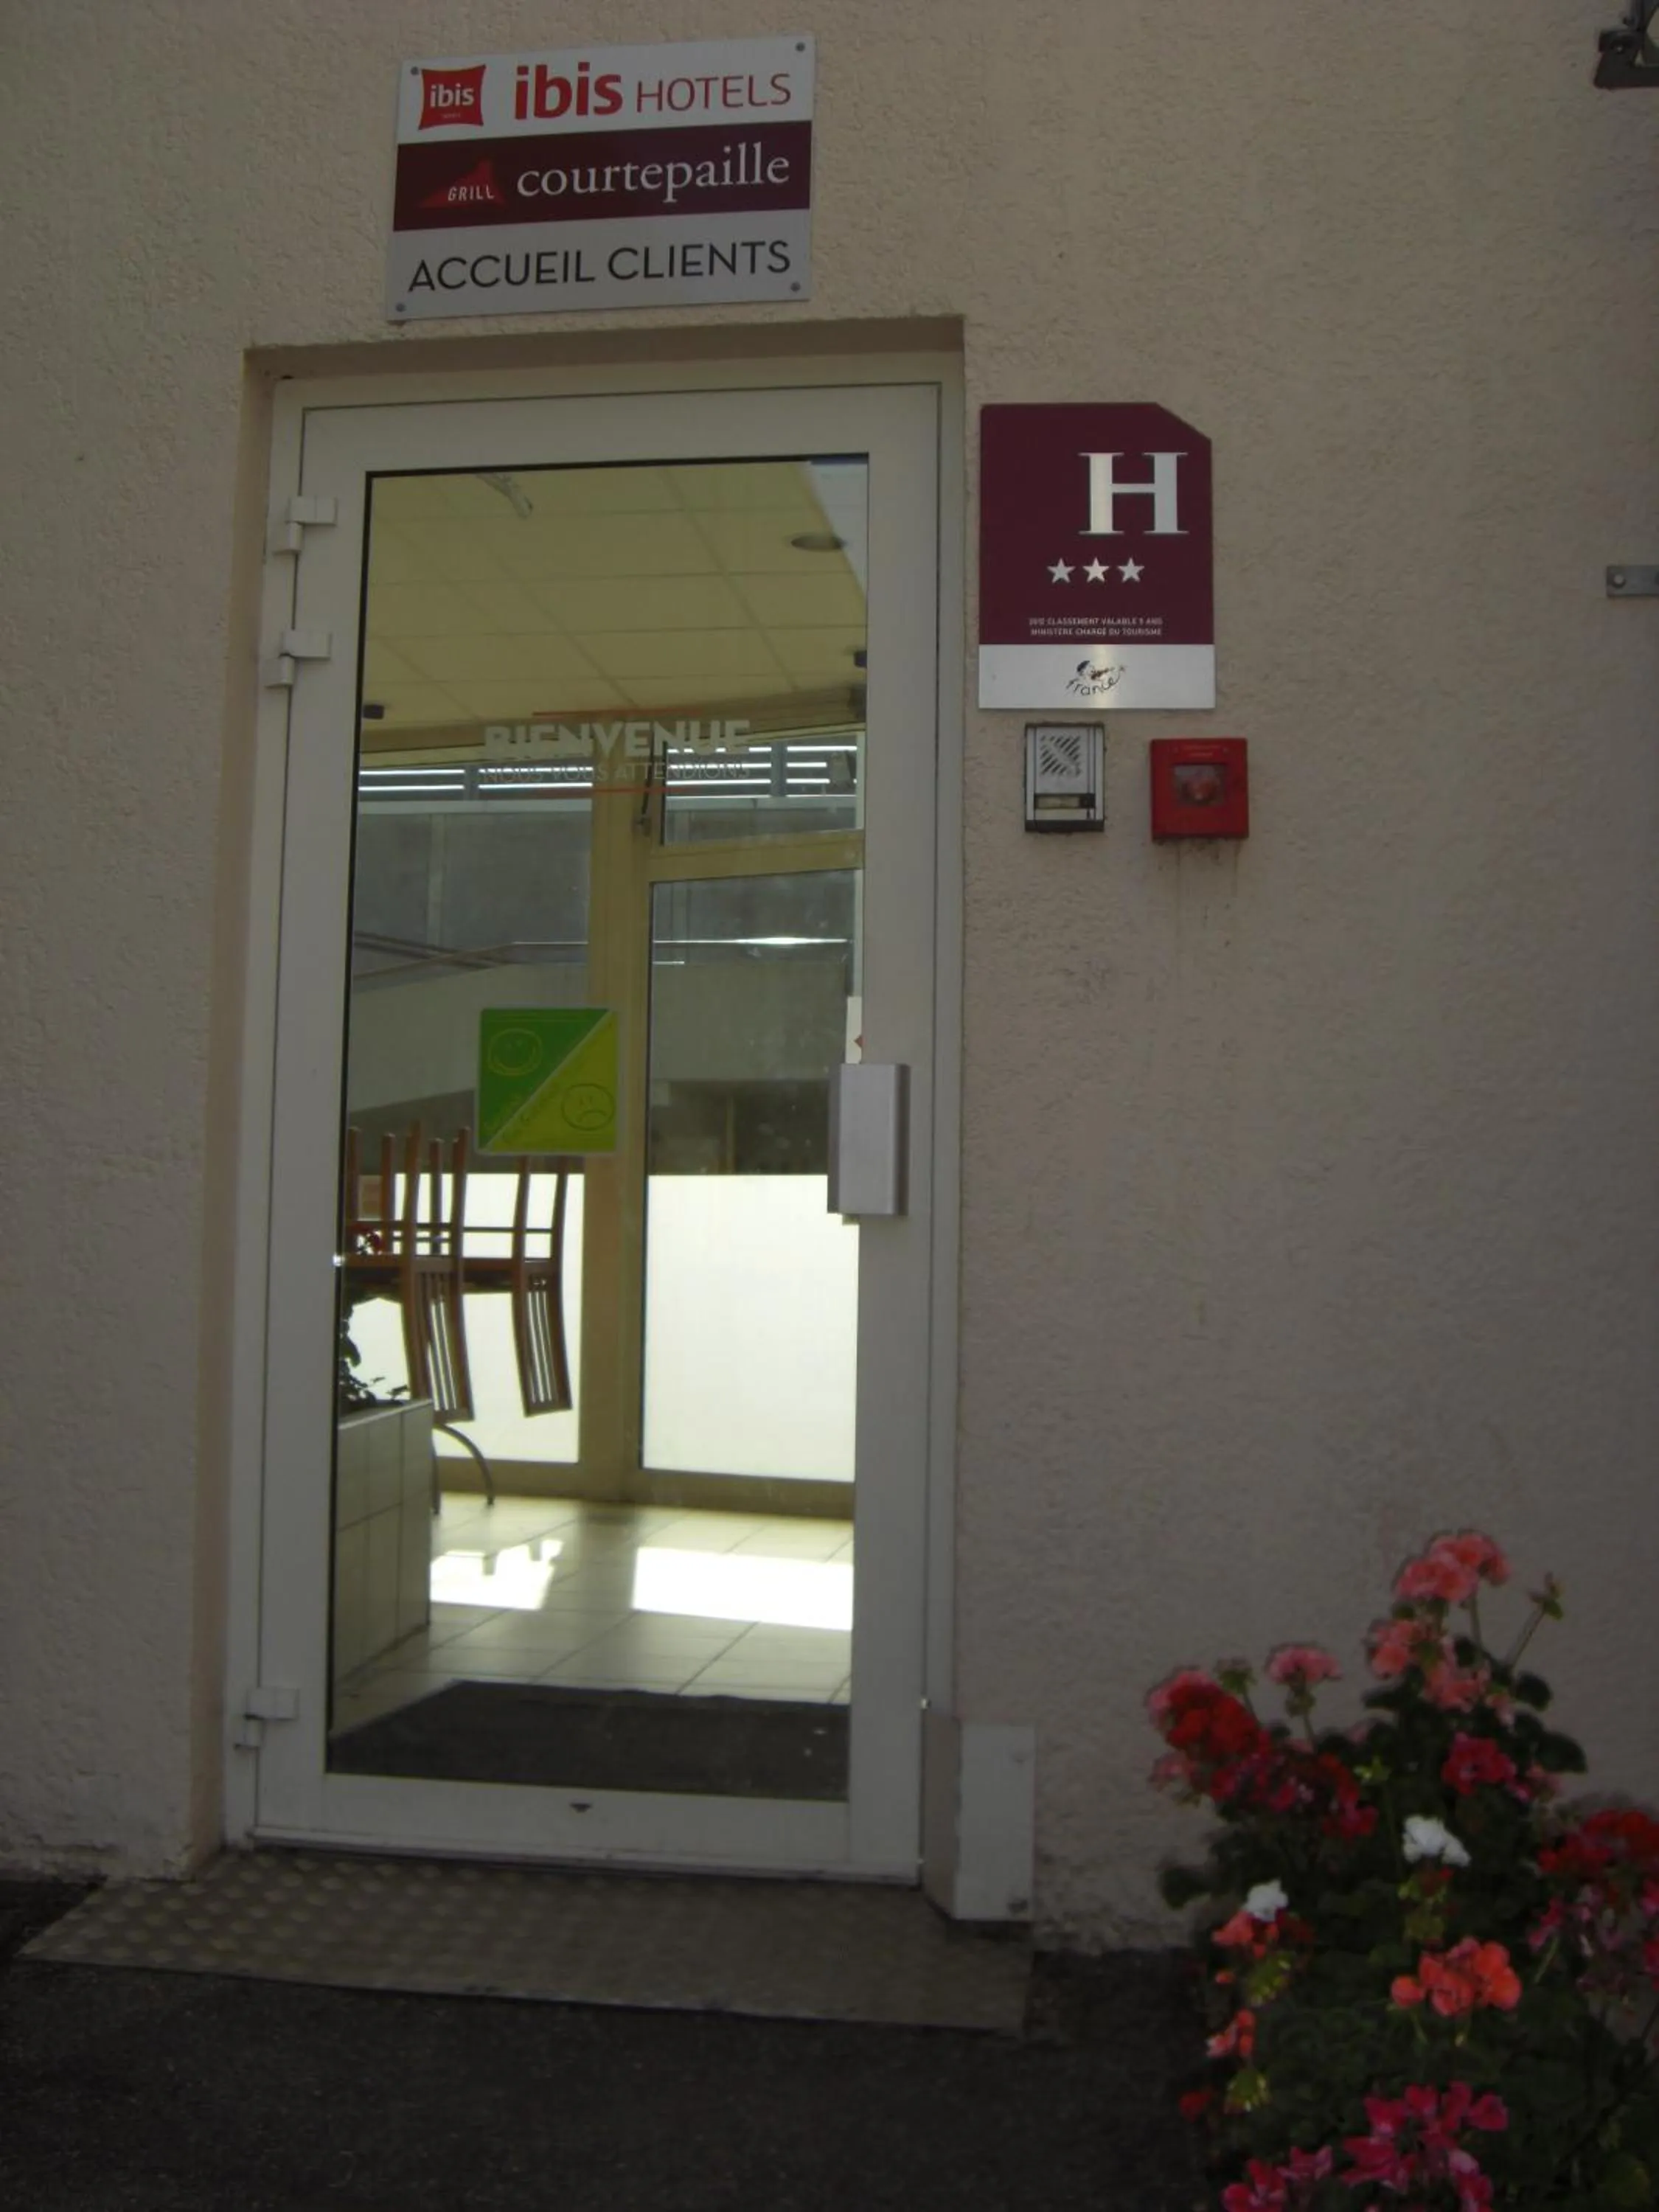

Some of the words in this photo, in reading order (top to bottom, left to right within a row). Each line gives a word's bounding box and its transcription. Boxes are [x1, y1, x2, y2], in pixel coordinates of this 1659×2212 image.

[428, 82, 474, 108] ibis
[515, 62, 623, 119] ibis
[636, 73, 791, 113] HOTELS
[448, 184, 495, 201] GRILL
[517, 142, 790, 203] courtepaille
[408, 251, 595, 292] ACCUEIL
[608, 240, 790, 281] CLIENTS
[1078, 452, 1189, 535] H
[484, 719, 751, 759] BIENVENUE
[552, 764, 609, 782] VOUS
[614, 761, 751, 782] ATTENDIONS
